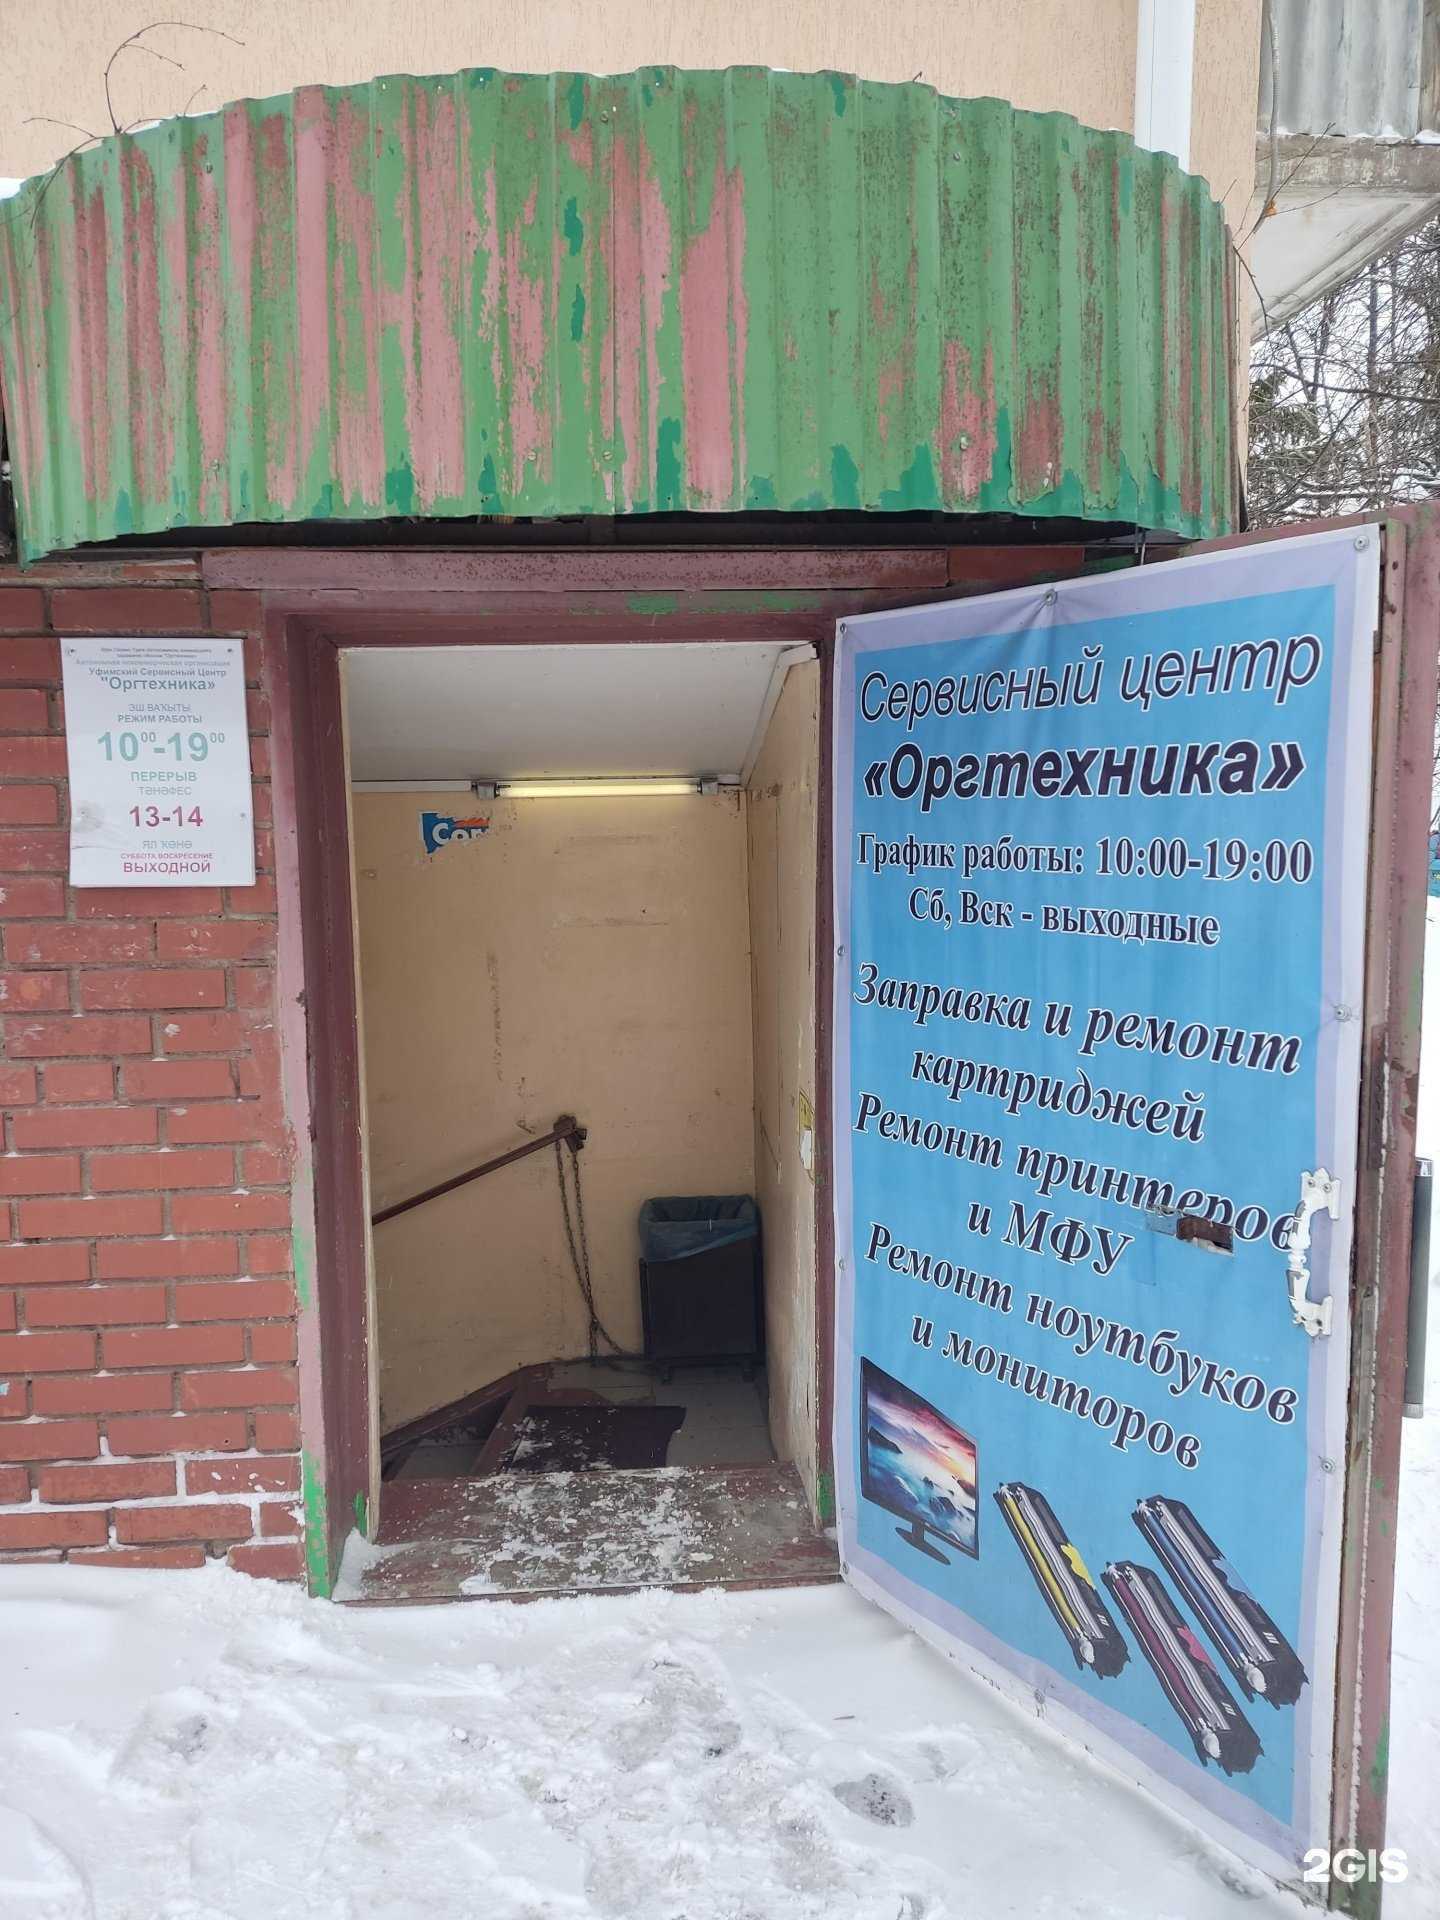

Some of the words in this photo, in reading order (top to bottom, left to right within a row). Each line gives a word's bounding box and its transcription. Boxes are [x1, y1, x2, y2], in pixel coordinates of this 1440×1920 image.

[89, 667, 138, 678] Уфимский
[140, 668, 195, 678] Сервисный
[197, 668, 227, 679] Центр
[861, 644, 1104, 731] Сервисный
[1120, 634, 1322, 712] центр
[118, 714, 156, 724] РЕЖИМ
[160, 714, 202, 724] РАБОТЫ
[131, 772, 198, 782] ПЕРЕРЫВ
[864, 740, 1306, 813] «Оргтехника»
[129, 805, 203, 827] 13-14
[123, 860, 211, 874] ВЫХОДНОЙ
[857, 833, 954, 875] График
[962, 835, 1084, 878] работы:
[1097, 837, 1314, 884] 10:00-19:00
[908, 887, 951, 928] Сб,
[959, 889, 1013, 927] Вск
[1041, 905, 1221, 946] выходные
[854, 963, 1031, 1027] Заправка
[1044, 1003, 1072, 1038] и
[1080, 1006, 1300, 1076] ремонт
[854, 1093, 1002, 1169] Ремонт
[912, 1051, 1206, 1143] картриджей
[968, 1200, 991, 1237] и
[1002, 1202, 1134, 1276] МФУ
[865, 1223, 1013, 1314] Ремонт
[1026, 1293, 1298, 1426] ноутбуков
[912, 1314, 933, 1348] и
[943, 1331, 1201, 1469] мониторов
